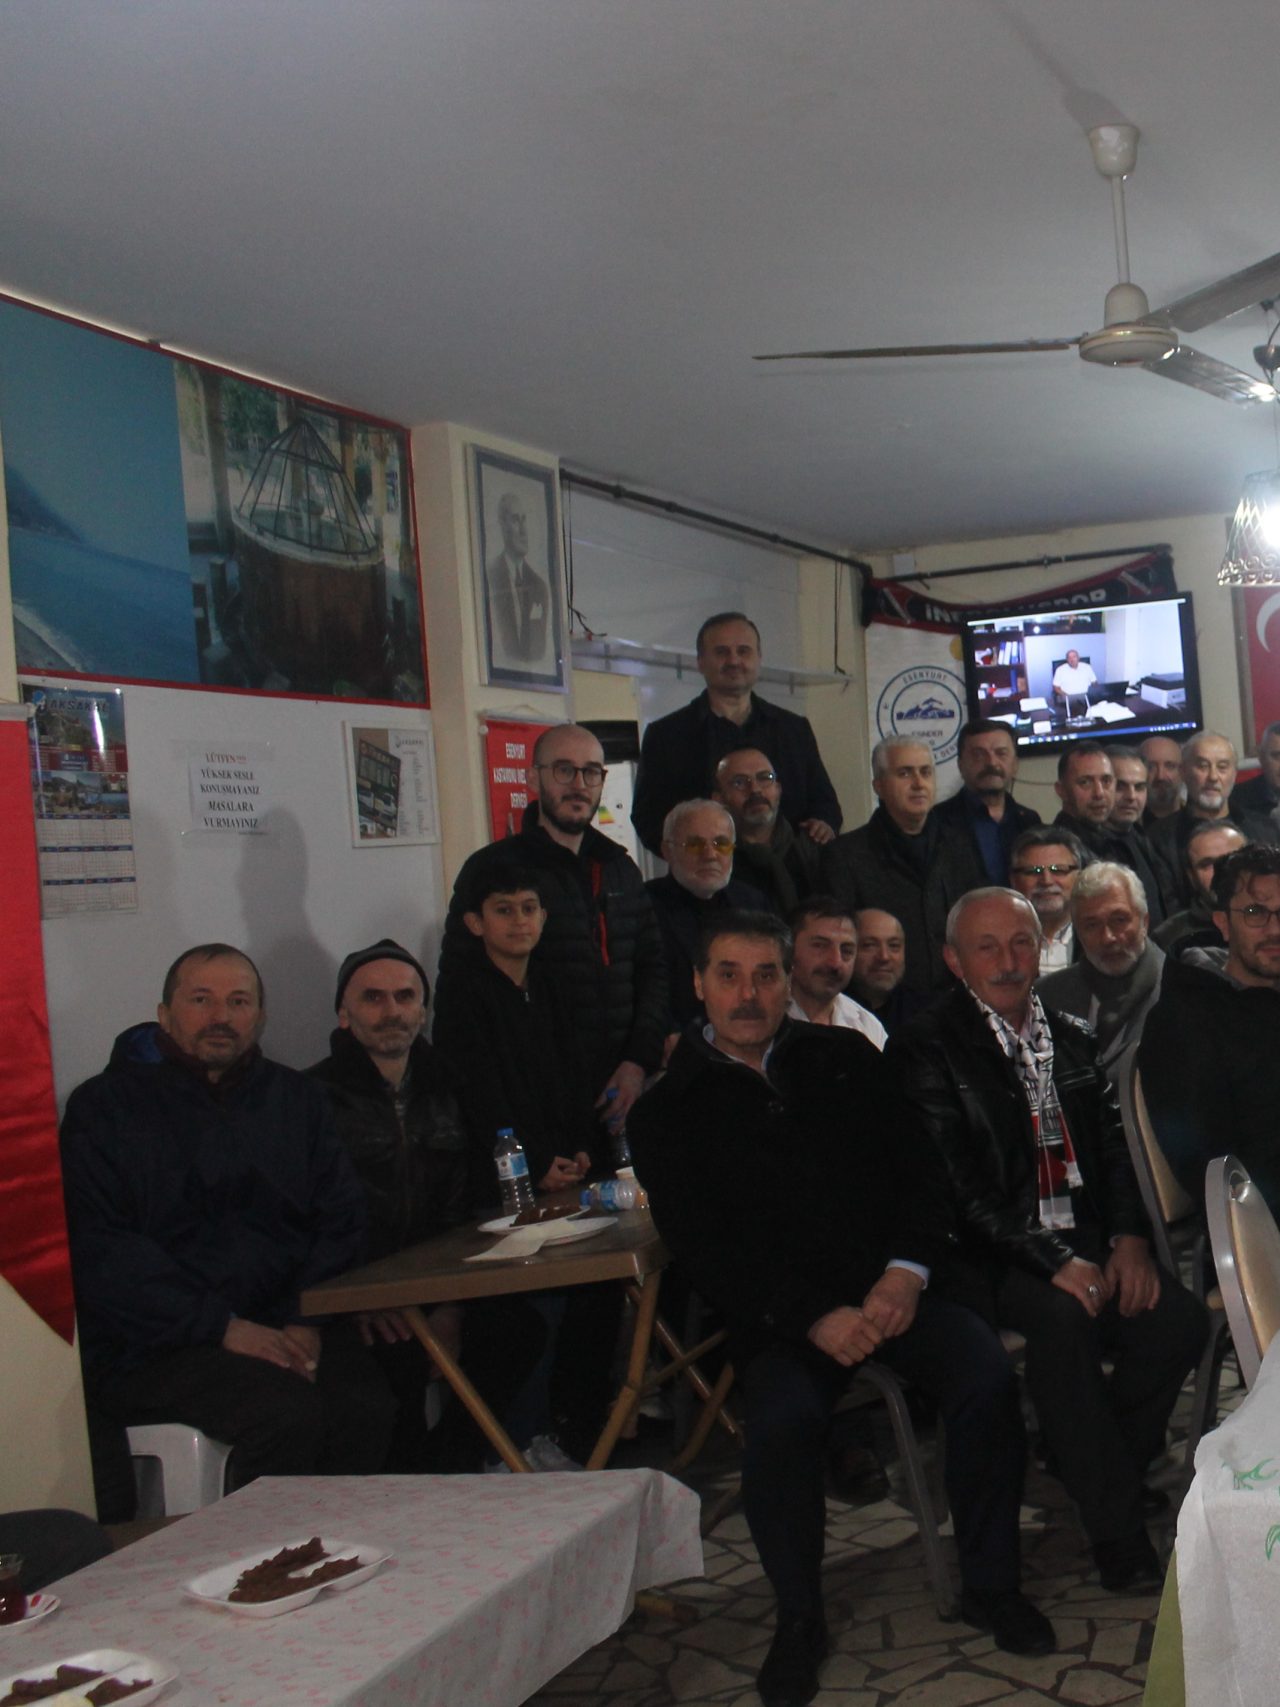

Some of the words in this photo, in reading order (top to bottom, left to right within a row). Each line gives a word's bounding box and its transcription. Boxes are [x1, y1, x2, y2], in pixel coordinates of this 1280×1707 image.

[903, 671, 947, 684] ESENYURT
[201, 767, 232, 779] YÜKSEK
[208, 800, 255, 812] MASALARA
[203, 817, 258, 828] VURMAYINIZ
